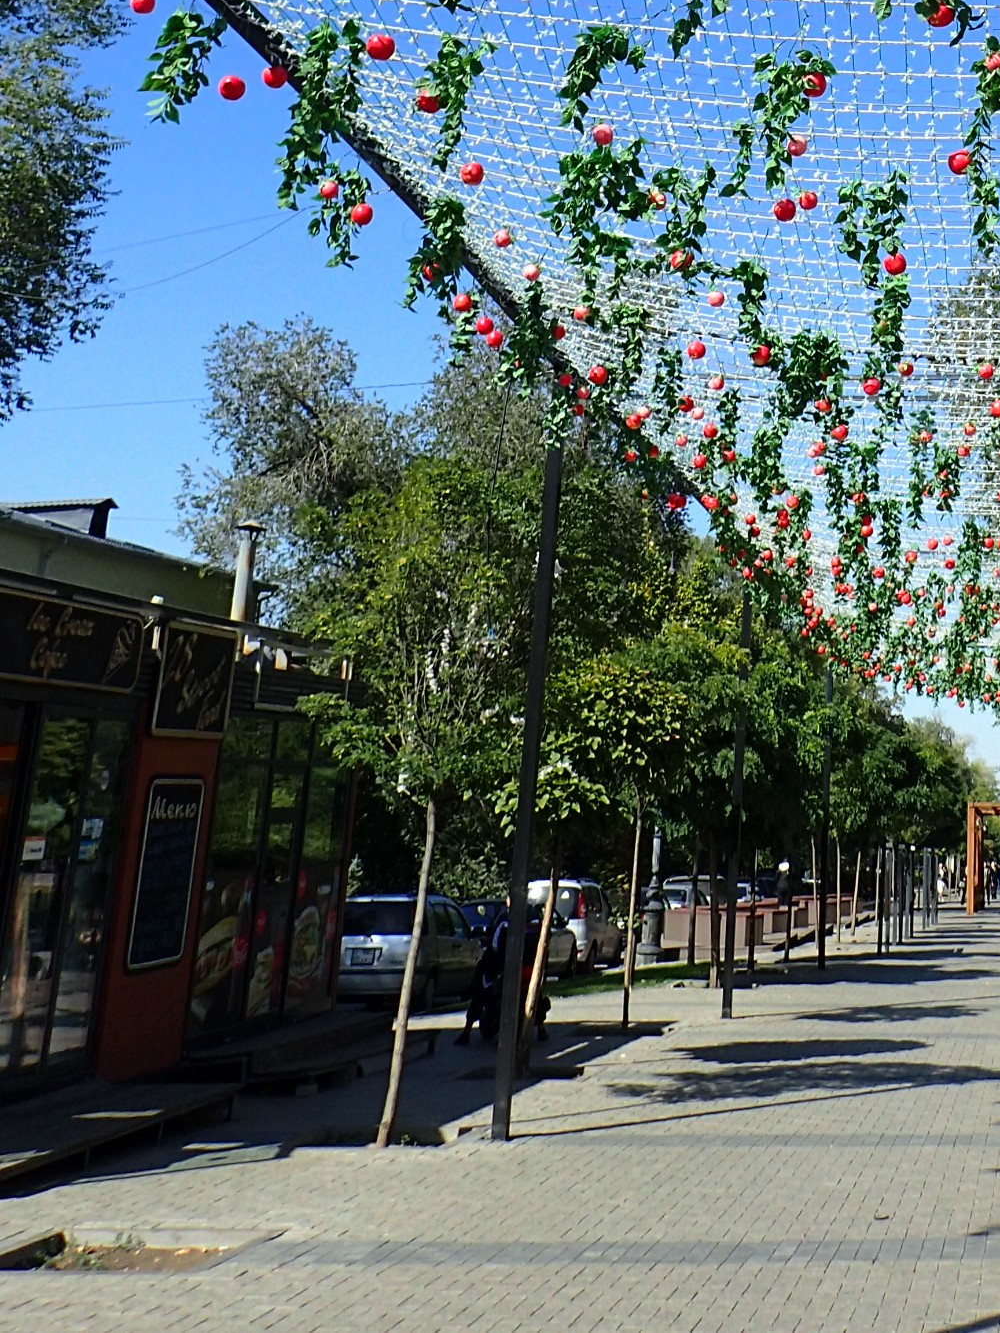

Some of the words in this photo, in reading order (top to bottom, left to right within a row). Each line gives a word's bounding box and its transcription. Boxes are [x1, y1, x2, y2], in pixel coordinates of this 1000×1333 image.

[26, 601, 50, 632] Ice
[55, 605, 96, 637] Cream
[151, 795, 198, 821] Меню
